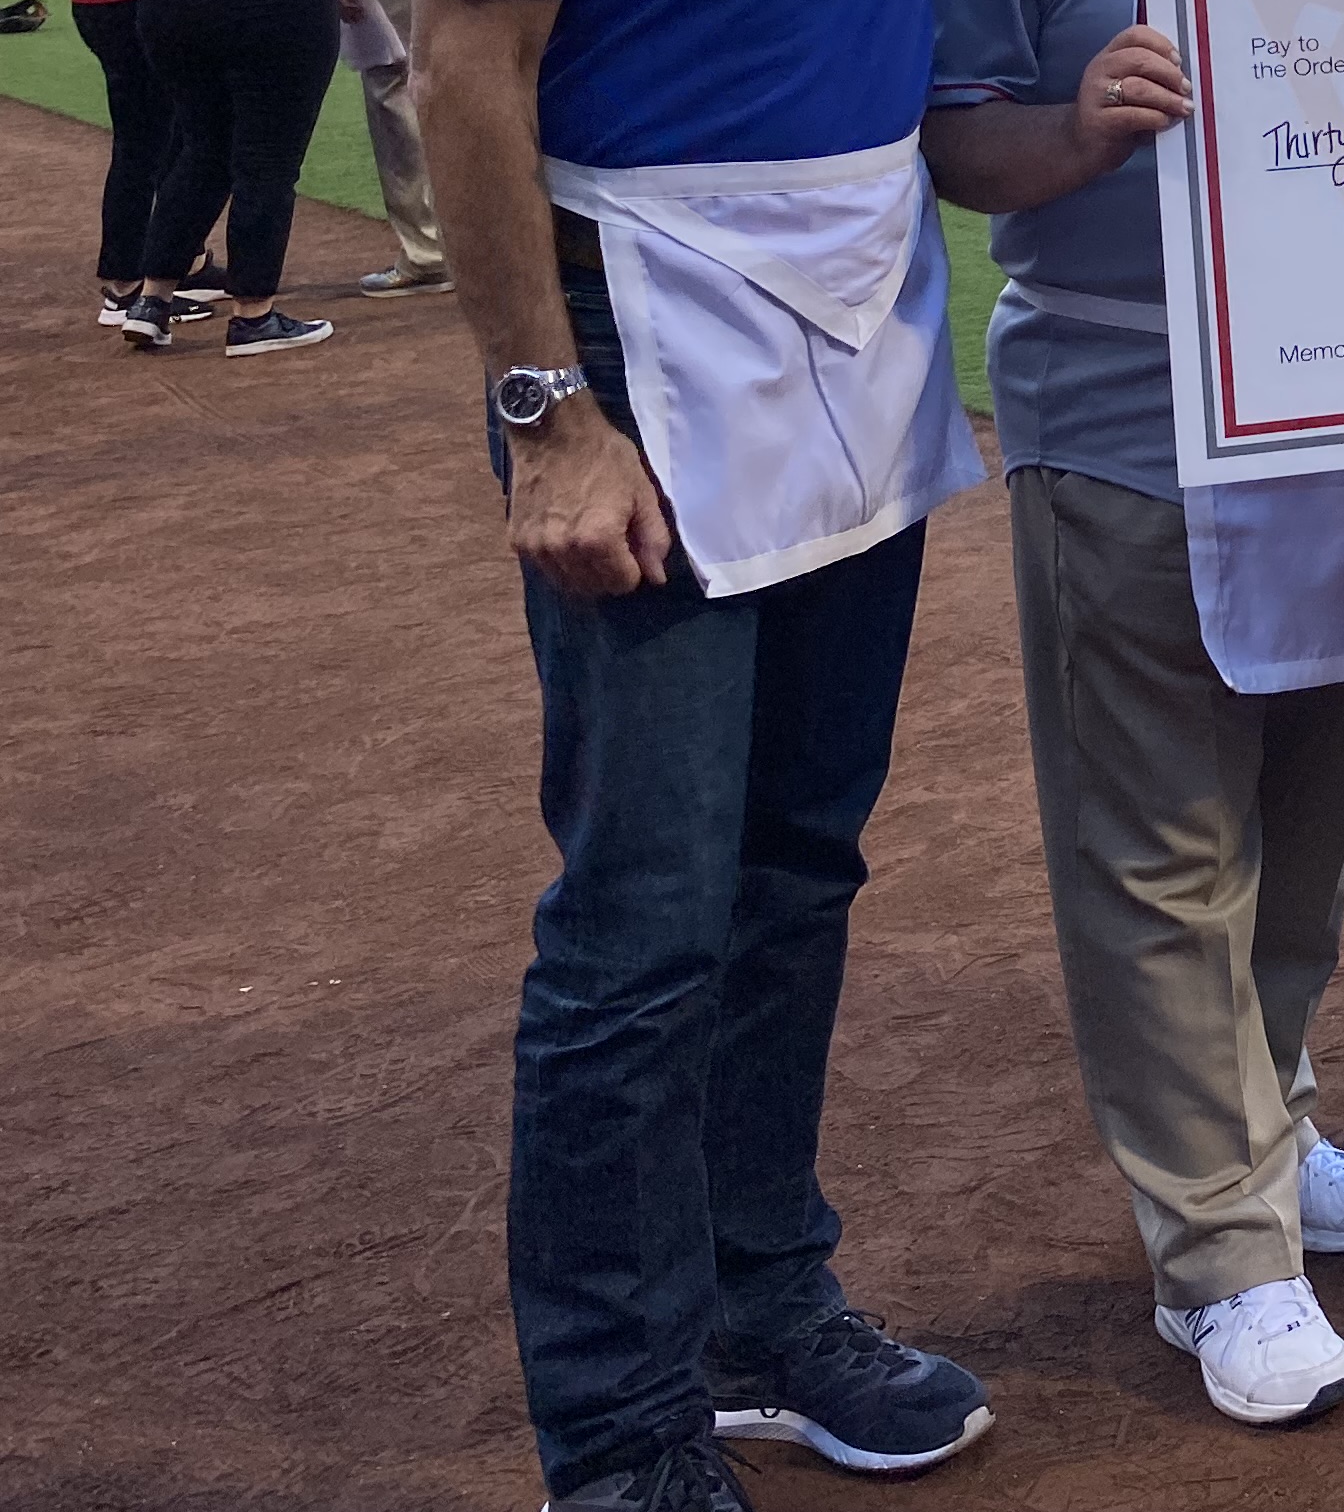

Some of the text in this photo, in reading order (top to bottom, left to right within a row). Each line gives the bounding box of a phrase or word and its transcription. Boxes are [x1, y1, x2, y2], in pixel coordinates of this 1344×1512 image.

[1251, 34, 1320, 60] Pay to
[1252, 59, 1286, 80] the
